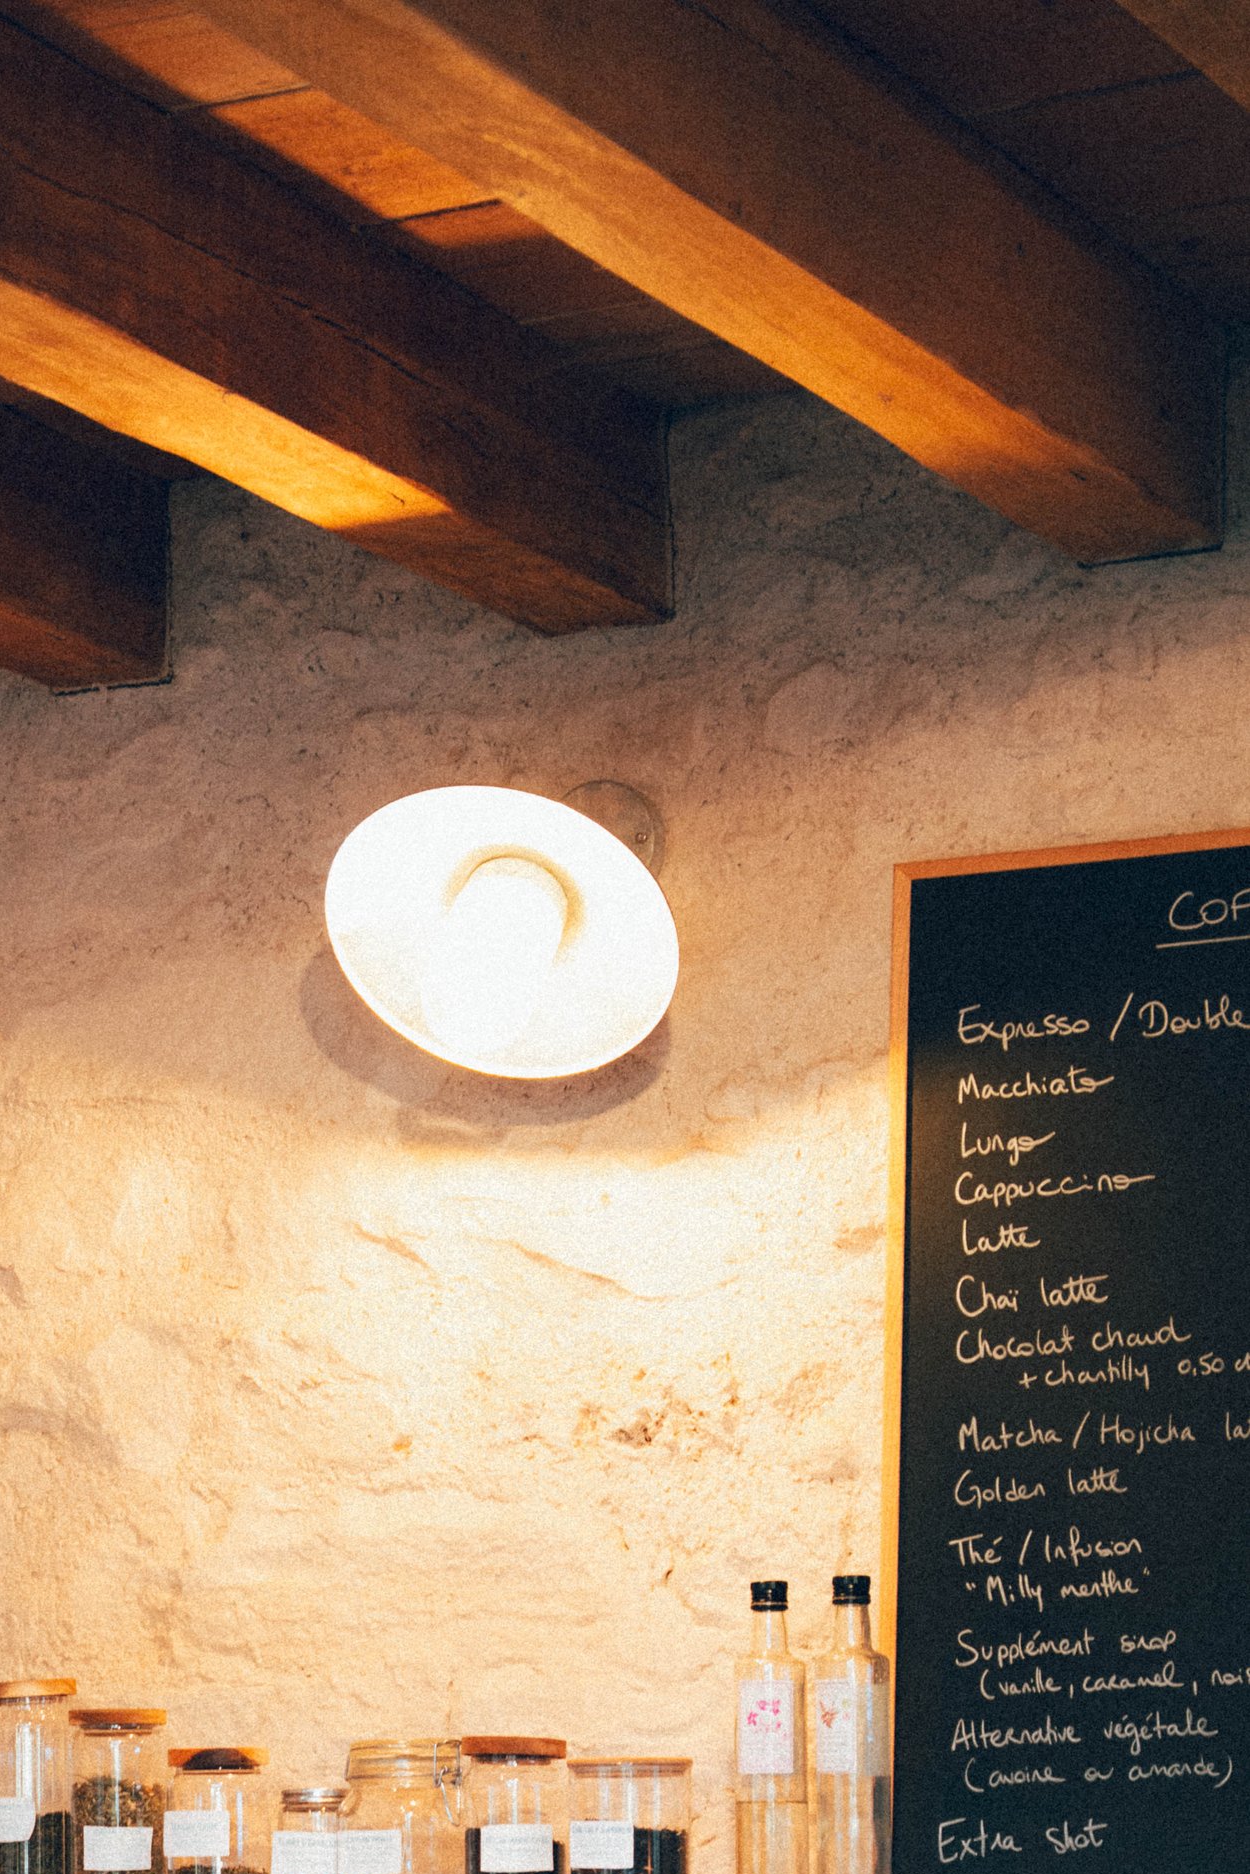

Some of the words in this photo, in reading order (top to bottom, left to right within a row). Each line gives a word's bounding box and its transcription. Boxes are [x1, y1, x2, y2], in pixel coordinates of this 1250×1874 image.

[958, 1003, 1091, 1051] Expresso
[1138, 995, 1250, 1038] Double
[959, 1065, 1114, 1104] Macchiato
[961, 1121, 1056, 1165] Lungo
[955, 1171, 1155, 1208] Cappuccino
[956, 1274, 1019, 1318] Chaï
[1041, 1275, 1109, 1306] latte
[956, 1324, 1076, 1365] Chocolat
[959, 1416, 1063, 1453] Matcha
[1100, 1413, 1196, 1456] Hojicha
[955, 1468, 1046, 1510] Golden
[1068, 1467, 1128, 1496] latte
[950, 1532, 1003, 1566] Thé
[1045, 1525, 1142, 1568] Infusion
[955, 1628, 1095, 1668] Supplément
[951, 1718, 1082, 1752] Alternative
[1104, 1708, 1219, 1755] végétale
[938, 1817, 1022, 1864] Extra
